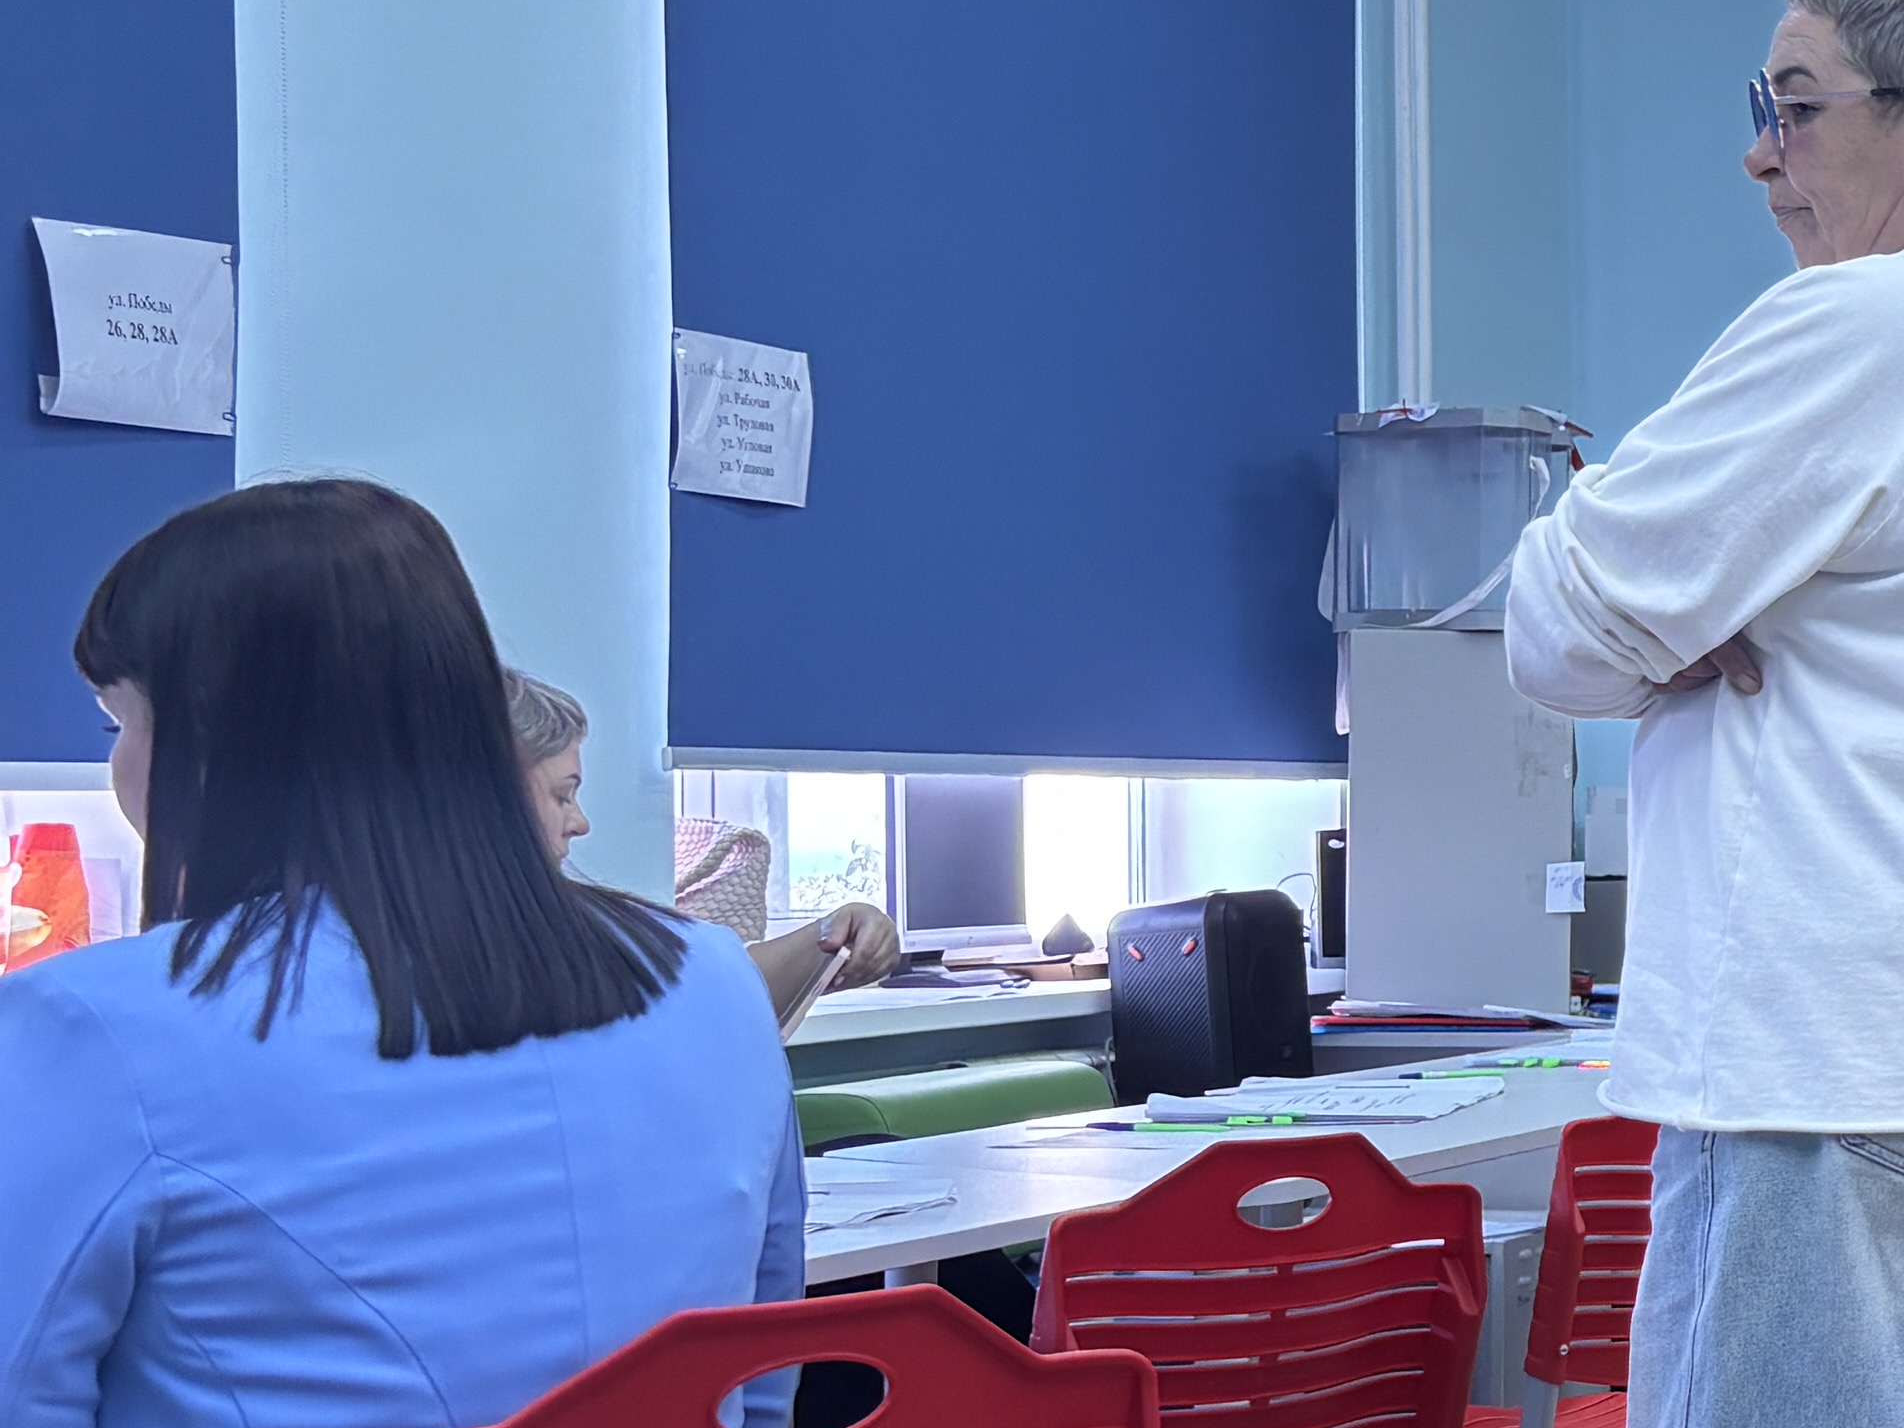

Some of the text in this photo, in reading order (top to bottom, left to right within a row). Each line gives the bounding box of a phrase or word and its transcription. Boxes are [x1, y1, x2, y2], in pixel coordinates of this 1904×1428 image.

[108, 294, 127, 310] ул.
[106, 318, 179, 346] 26, 28, 28А
